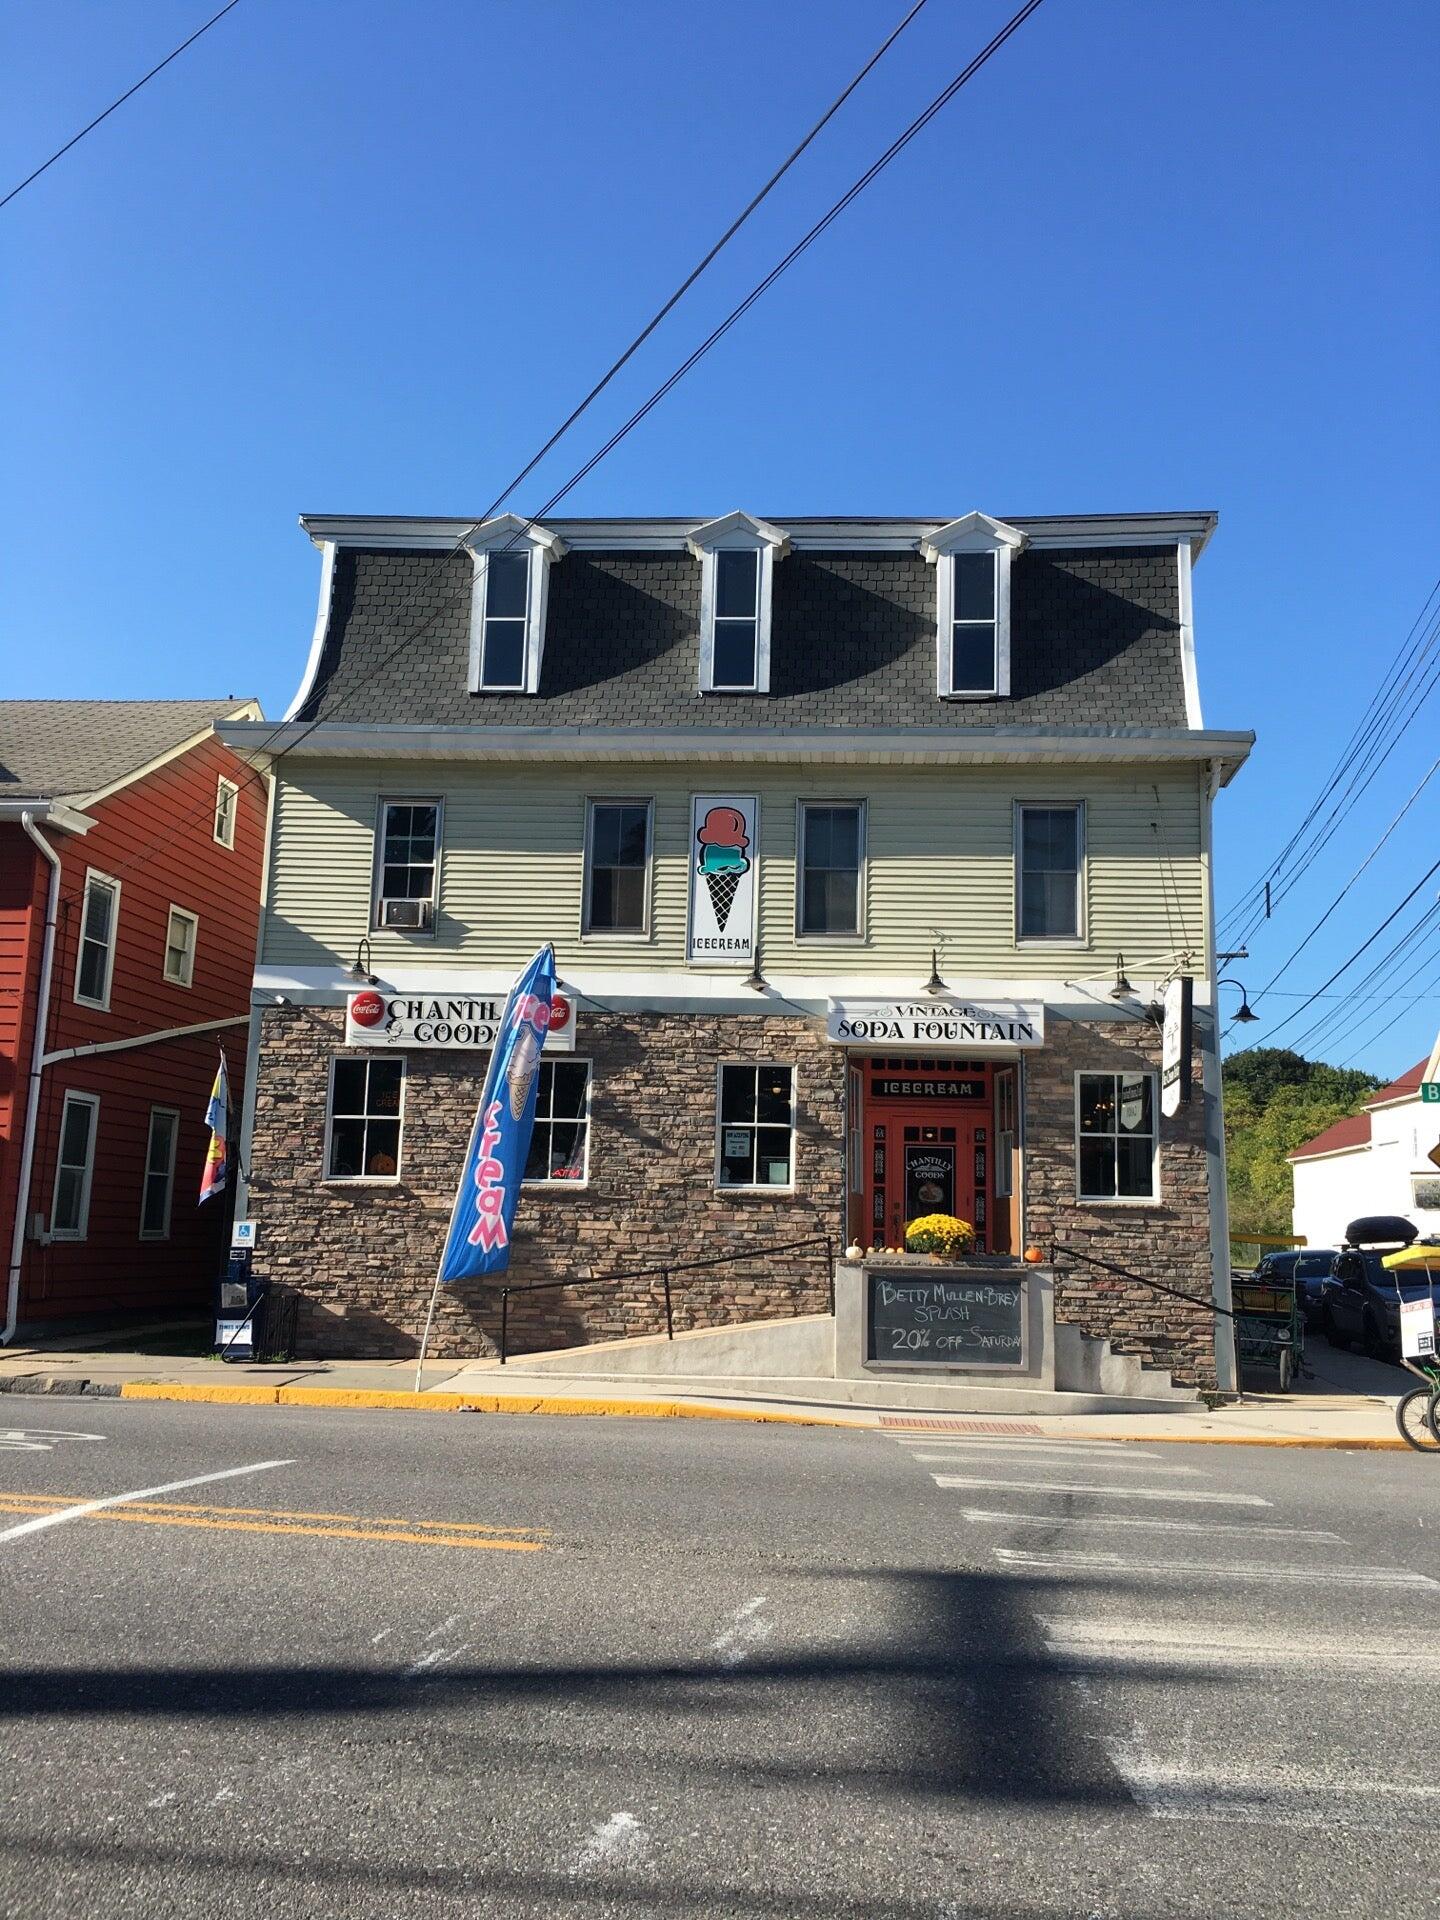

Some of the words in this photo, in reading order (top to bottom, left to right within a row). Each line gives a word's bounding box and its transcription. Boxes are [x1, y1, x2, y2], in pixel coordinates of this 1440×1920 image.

[693, 938, 750, 950] ICECREAM
[352, 1003, 380, 1015] Coca-Cola
[387, 999, 502, 1021] CHANTIL
[895, 1005, 976, 1018] VINTAGE
[413, 1022, 499, 1044] GOOD
[838, 1019, 904, 1039] SODA
[912, 1021, 1033, 1040] FOUNTAIN
[884, 1082, 972, 1095] ICECREAM
[906, 1156, 952, 1171] CHANTILLY
[552, 1168, 581, 1179] ATM
[915, 1171, 945, 1179] GOODS
[877, 1281, 929, 1306] BETTY
[914, 1305, 969, 1322] SPLASH
[892, 1328, 930, 1350] 20%
[936, 1336, 963, 1350] OFF
